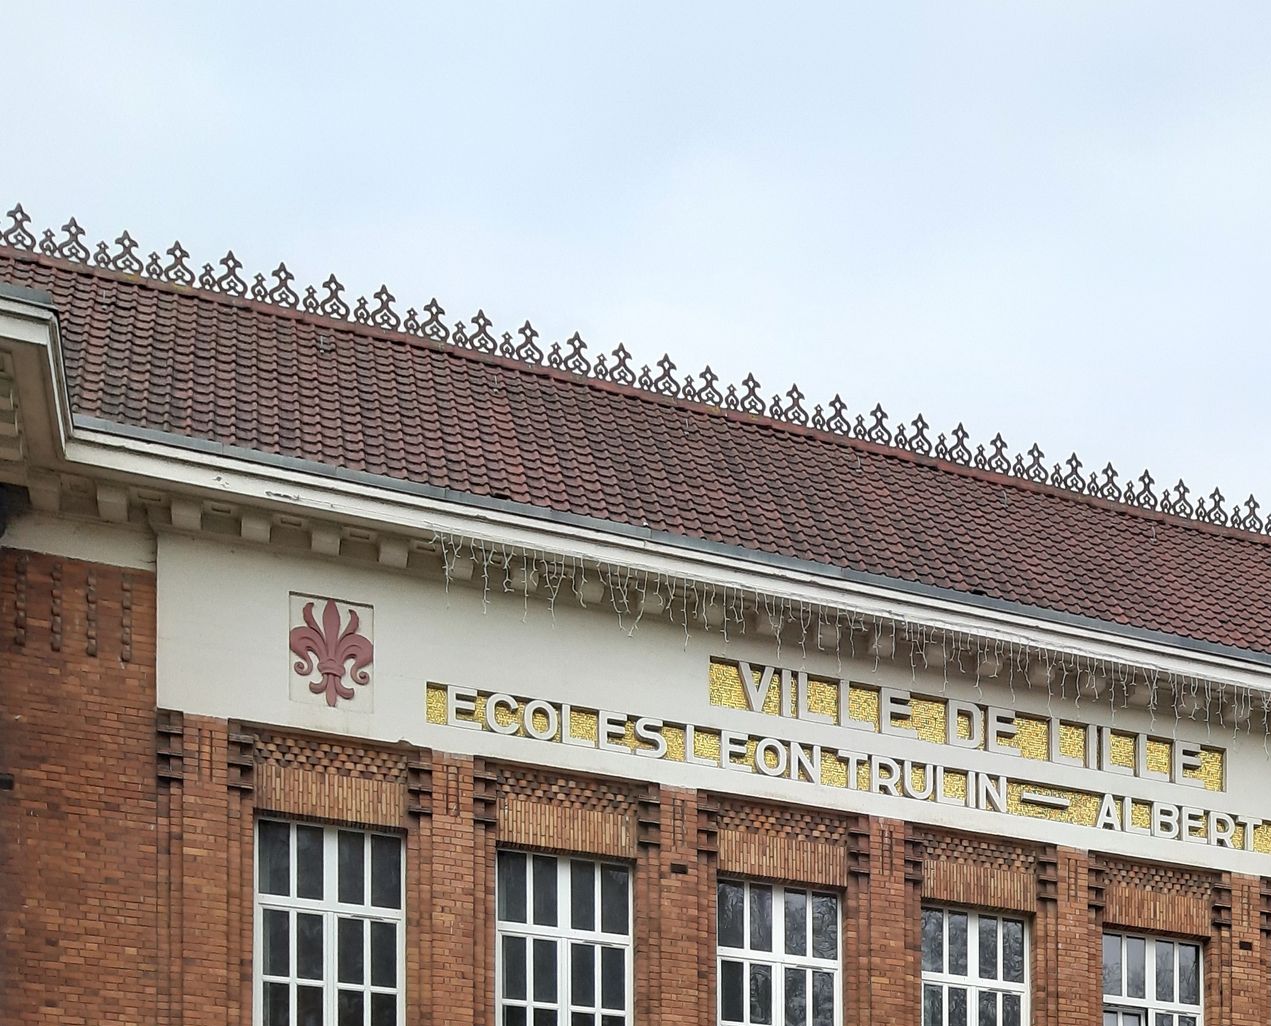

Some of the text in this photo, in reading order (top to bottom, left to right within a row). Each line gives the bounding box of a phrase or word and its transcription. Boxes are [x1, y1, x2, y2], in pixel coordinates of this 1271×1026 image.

[447, 684, 668, 760] ECOLES
[686, 724, 821, 785] LEON
[837, 749, 1008, 814] TRULIN
[1096, 793, 1262, 852] ALBERT
[738, 660, 1206, 788] VILLE DE LILLE
